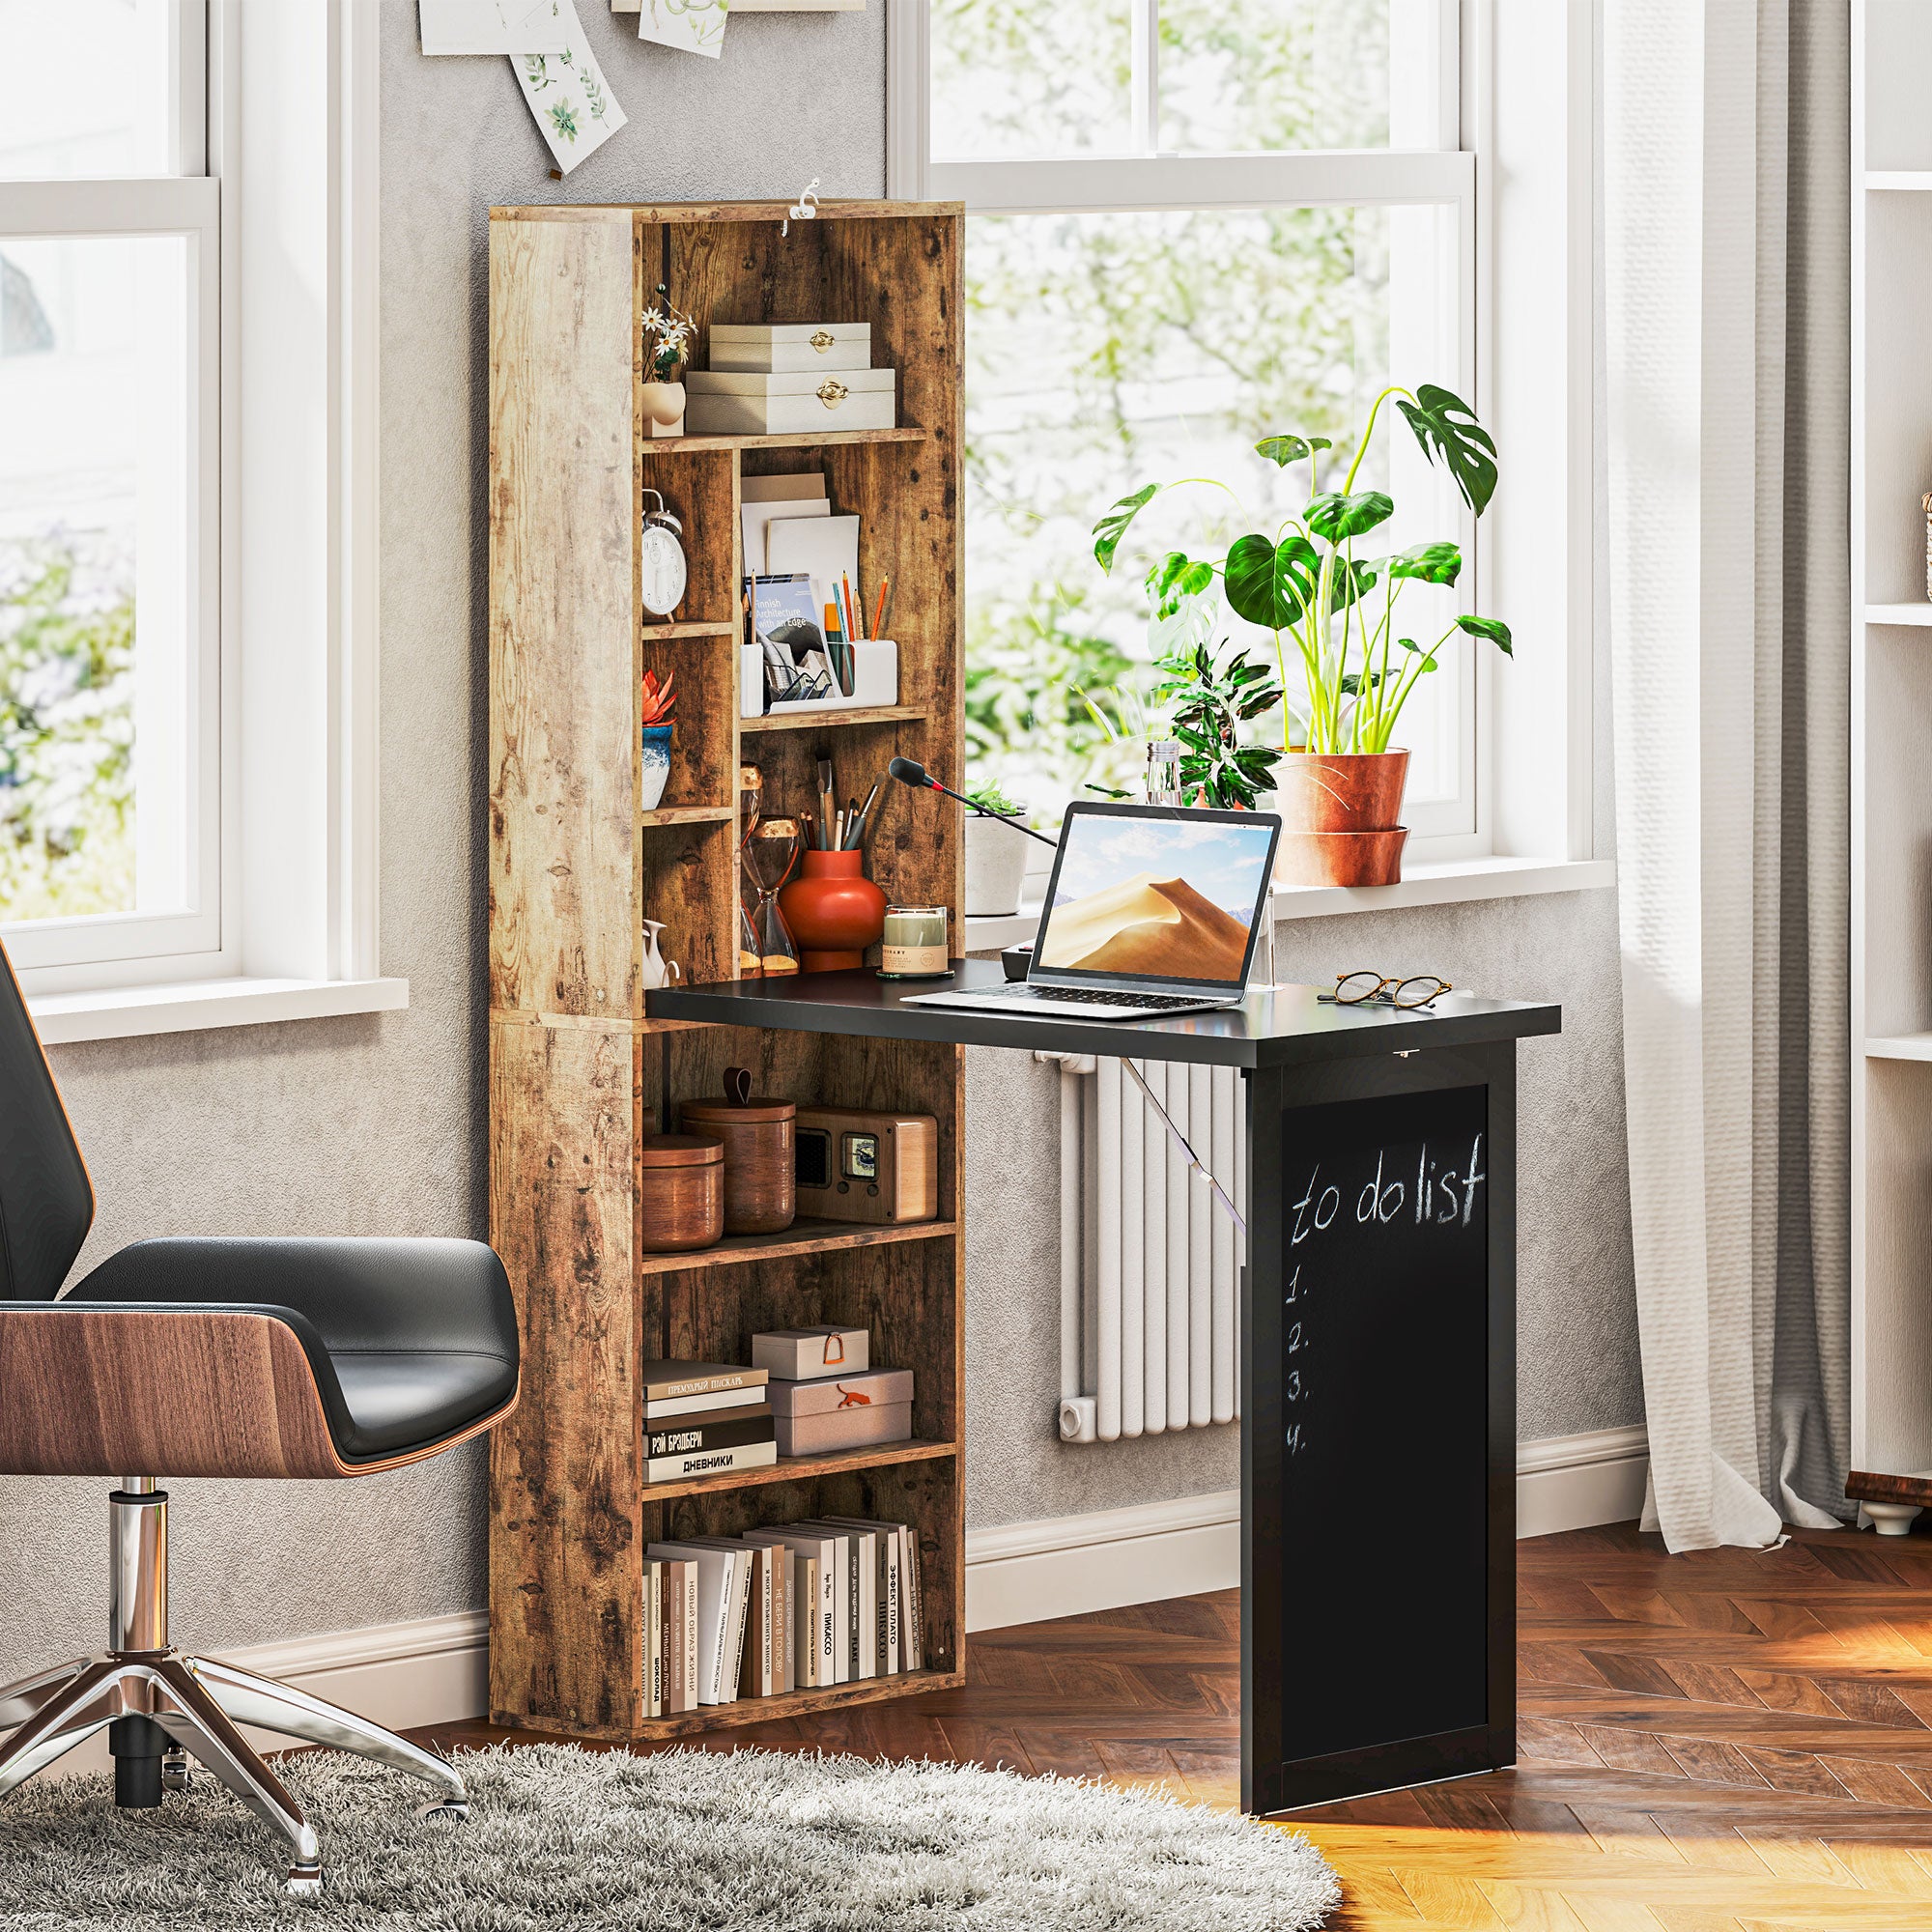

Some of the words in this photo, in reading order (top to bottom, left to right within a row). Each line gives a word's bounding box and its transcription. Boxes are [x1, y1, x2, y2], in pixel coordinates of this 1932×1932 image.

[755, 598, 781, 608] innish
[756, 609, 801, 618] Architecture
[758, 619, 774, 628] with
[787, 618, 807, 628] Edge
[1291, 1162, 1340, 1246] to
[1356, 1150, 1406, 1224] do
[1415, 1132, 1486, 1228] list
[1285, 1264, 1308, 1304] 1.
[1288, 1321, 1309, 1354] 2.
[668, 1379, 709, 1395] ПРЕМУДРЫЙ
[711, 1377, 743, 1389] ПИСКАРЬ
[1287, 1370, 1309, 1402] 3.
[651, 1433, 666, 1454] РЭЙ
[668, 1430, 702, 1452] БРЭДБЕРИ
[683, 1454, 734, 1473] ДНЕВНИКИ
[775, 1588, 782, 1601] НЕ
[878, 1601, 887, 1659] ПИКАССО
